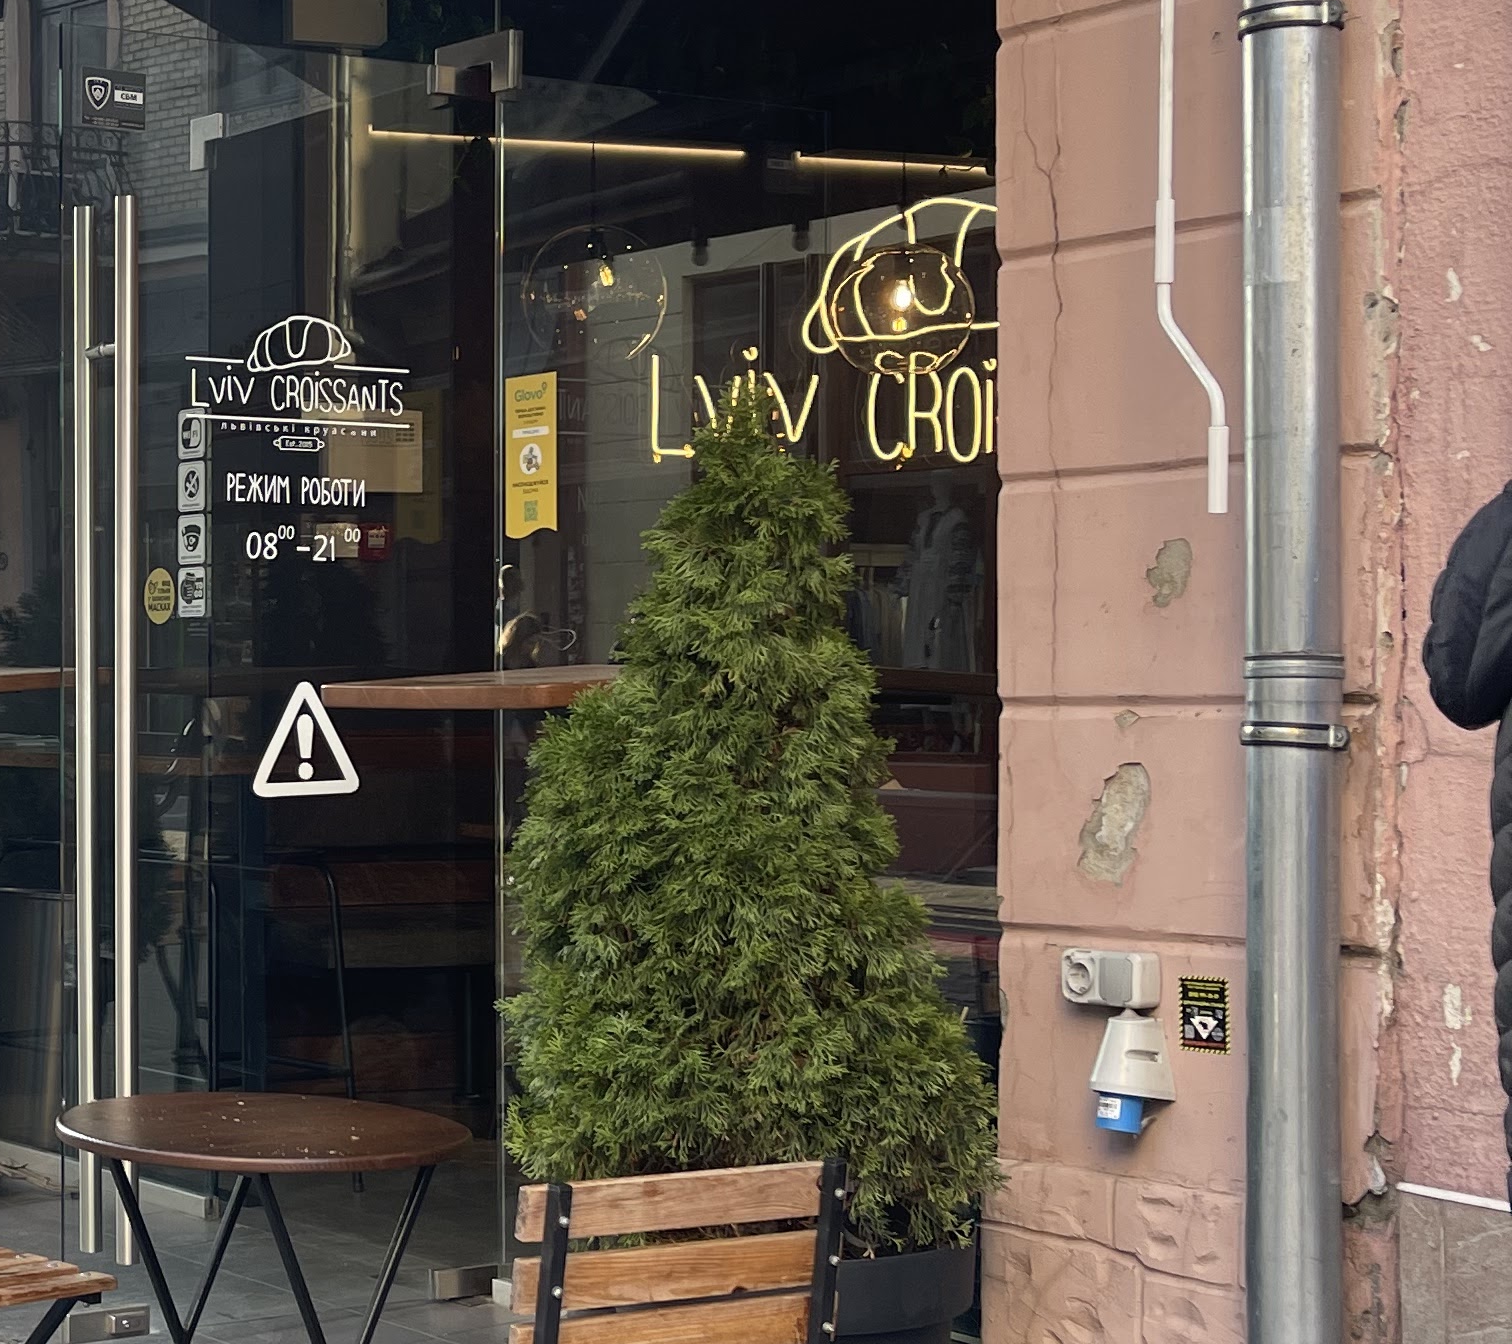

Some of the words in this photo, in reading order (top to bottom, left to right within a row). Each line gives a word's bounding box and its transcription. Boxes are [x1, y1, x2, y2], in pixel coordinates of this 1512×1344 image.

[514, 388, 544, 403] Glovo
[220, 421, 296, 433] львівські
[226, 472, 290, 504] РЕЖИМ
[301, 476, 366, 507] РОБОТИ
